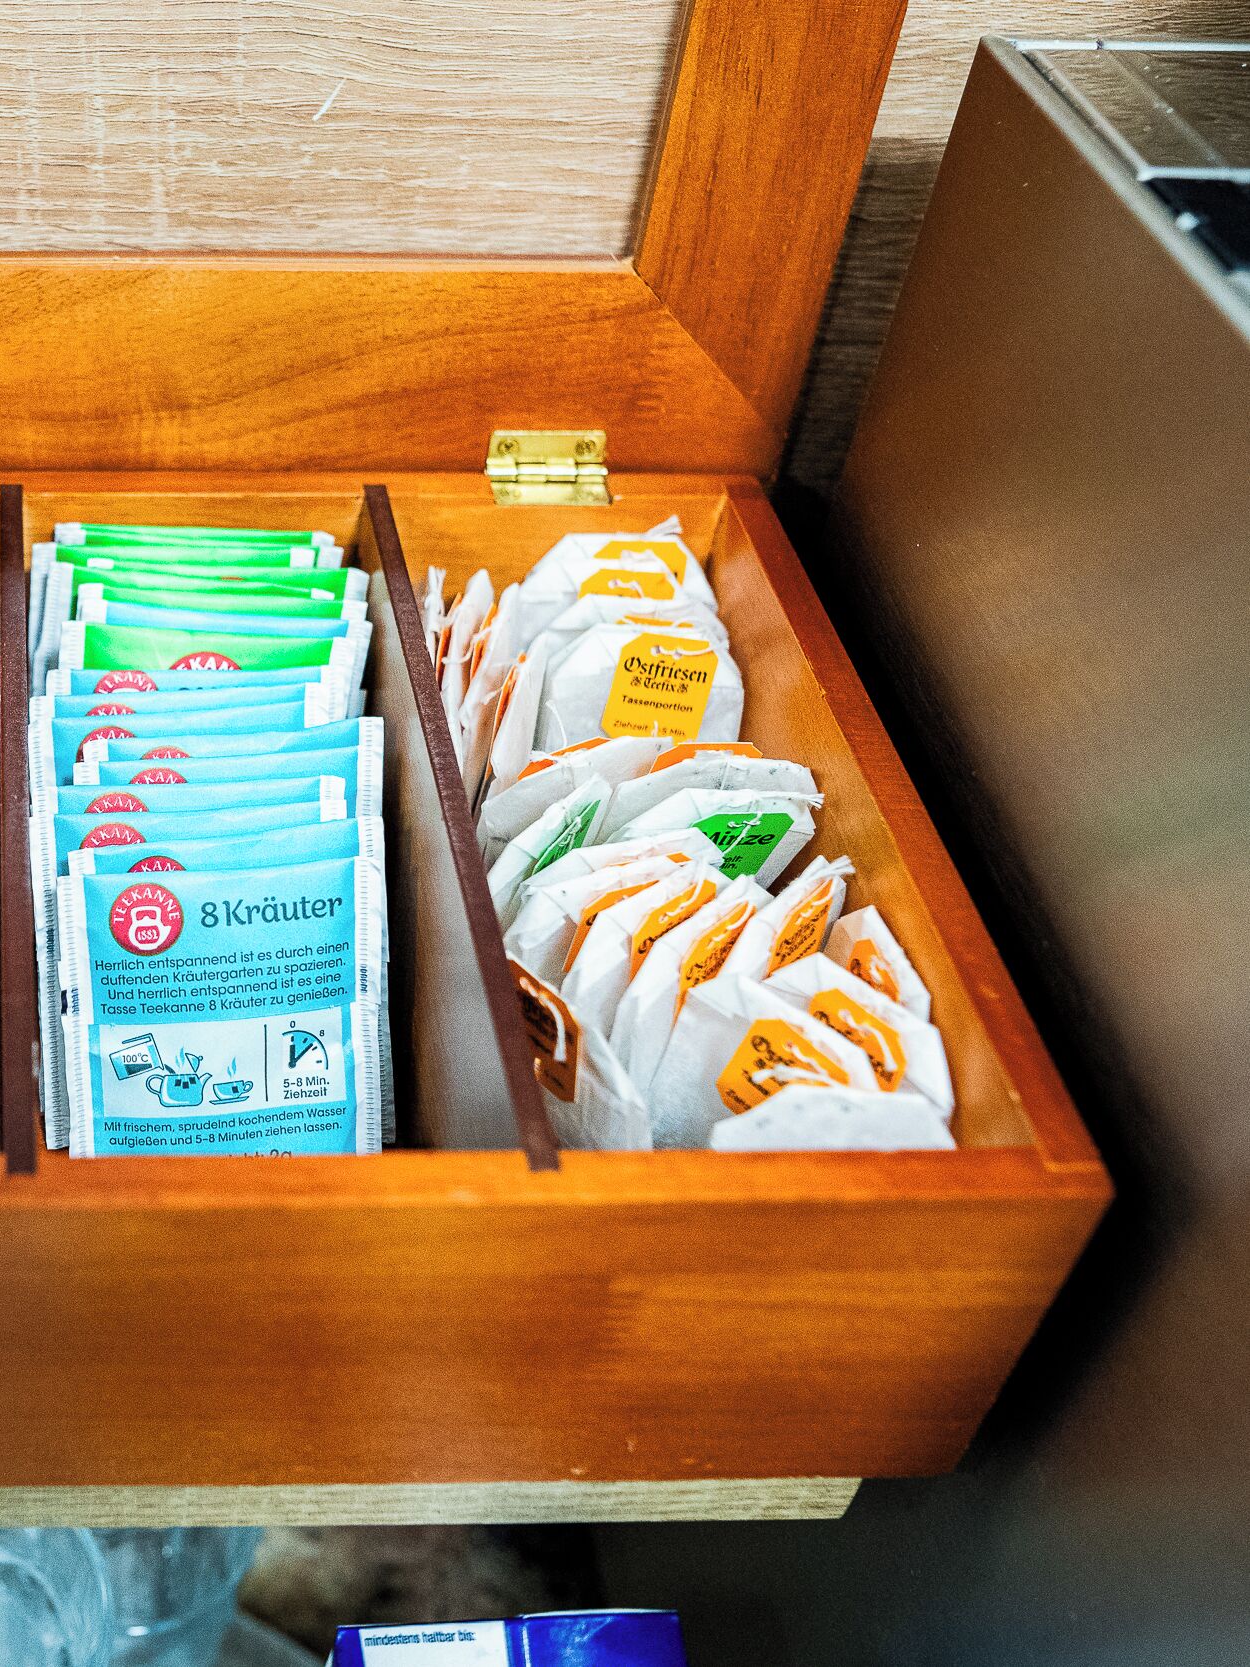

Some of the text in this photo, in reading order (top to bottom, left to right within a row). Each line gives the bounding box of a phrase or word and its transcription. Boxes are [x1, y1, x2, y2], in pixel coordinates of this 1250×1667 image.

[624, 657, 707, 683] Ostfriesen
[622, 695, 693, 712] Tassenportion
[113, 887, 181, 924] TEEKANNE
[200, 896, 343, 928] 8 Kräuter
[137, 927, 159, 942] 1882
[95, 941, 349, 971] Herrlich entspannend ist es durch einen
[100, 957, 346, 986] duftenden Kräutergarten zu spazieren.
[108, 972, 341, 1000] Und herrlich entspannend ist es eine
[100, 986, 348, 1015] Tasse Teekanne 8 Kräuter zu genießen.
[289, 1020, 296, 1029] 0
[122, 1052, 149, 1064] 100°C
[283, 1086, 328, 1100] Ziehzeit
[305, 1076, 330, 1087] Min.
[104, 1107, 347, 1133] Mit frischem, sprudelnd kochendem Wasser
[109, 1136, 168, 1148] aufgießen
[170, 1135, 193, 1145] und
[218, 1130, 263, 1142] Minuten
[265, 1125, 302, 1137] ziehen
[303, 1121, 343, 1133] lassen.
[364, 1633, 420, 1647] mindestens
[421, 1631, 456, 1643] haltbar
